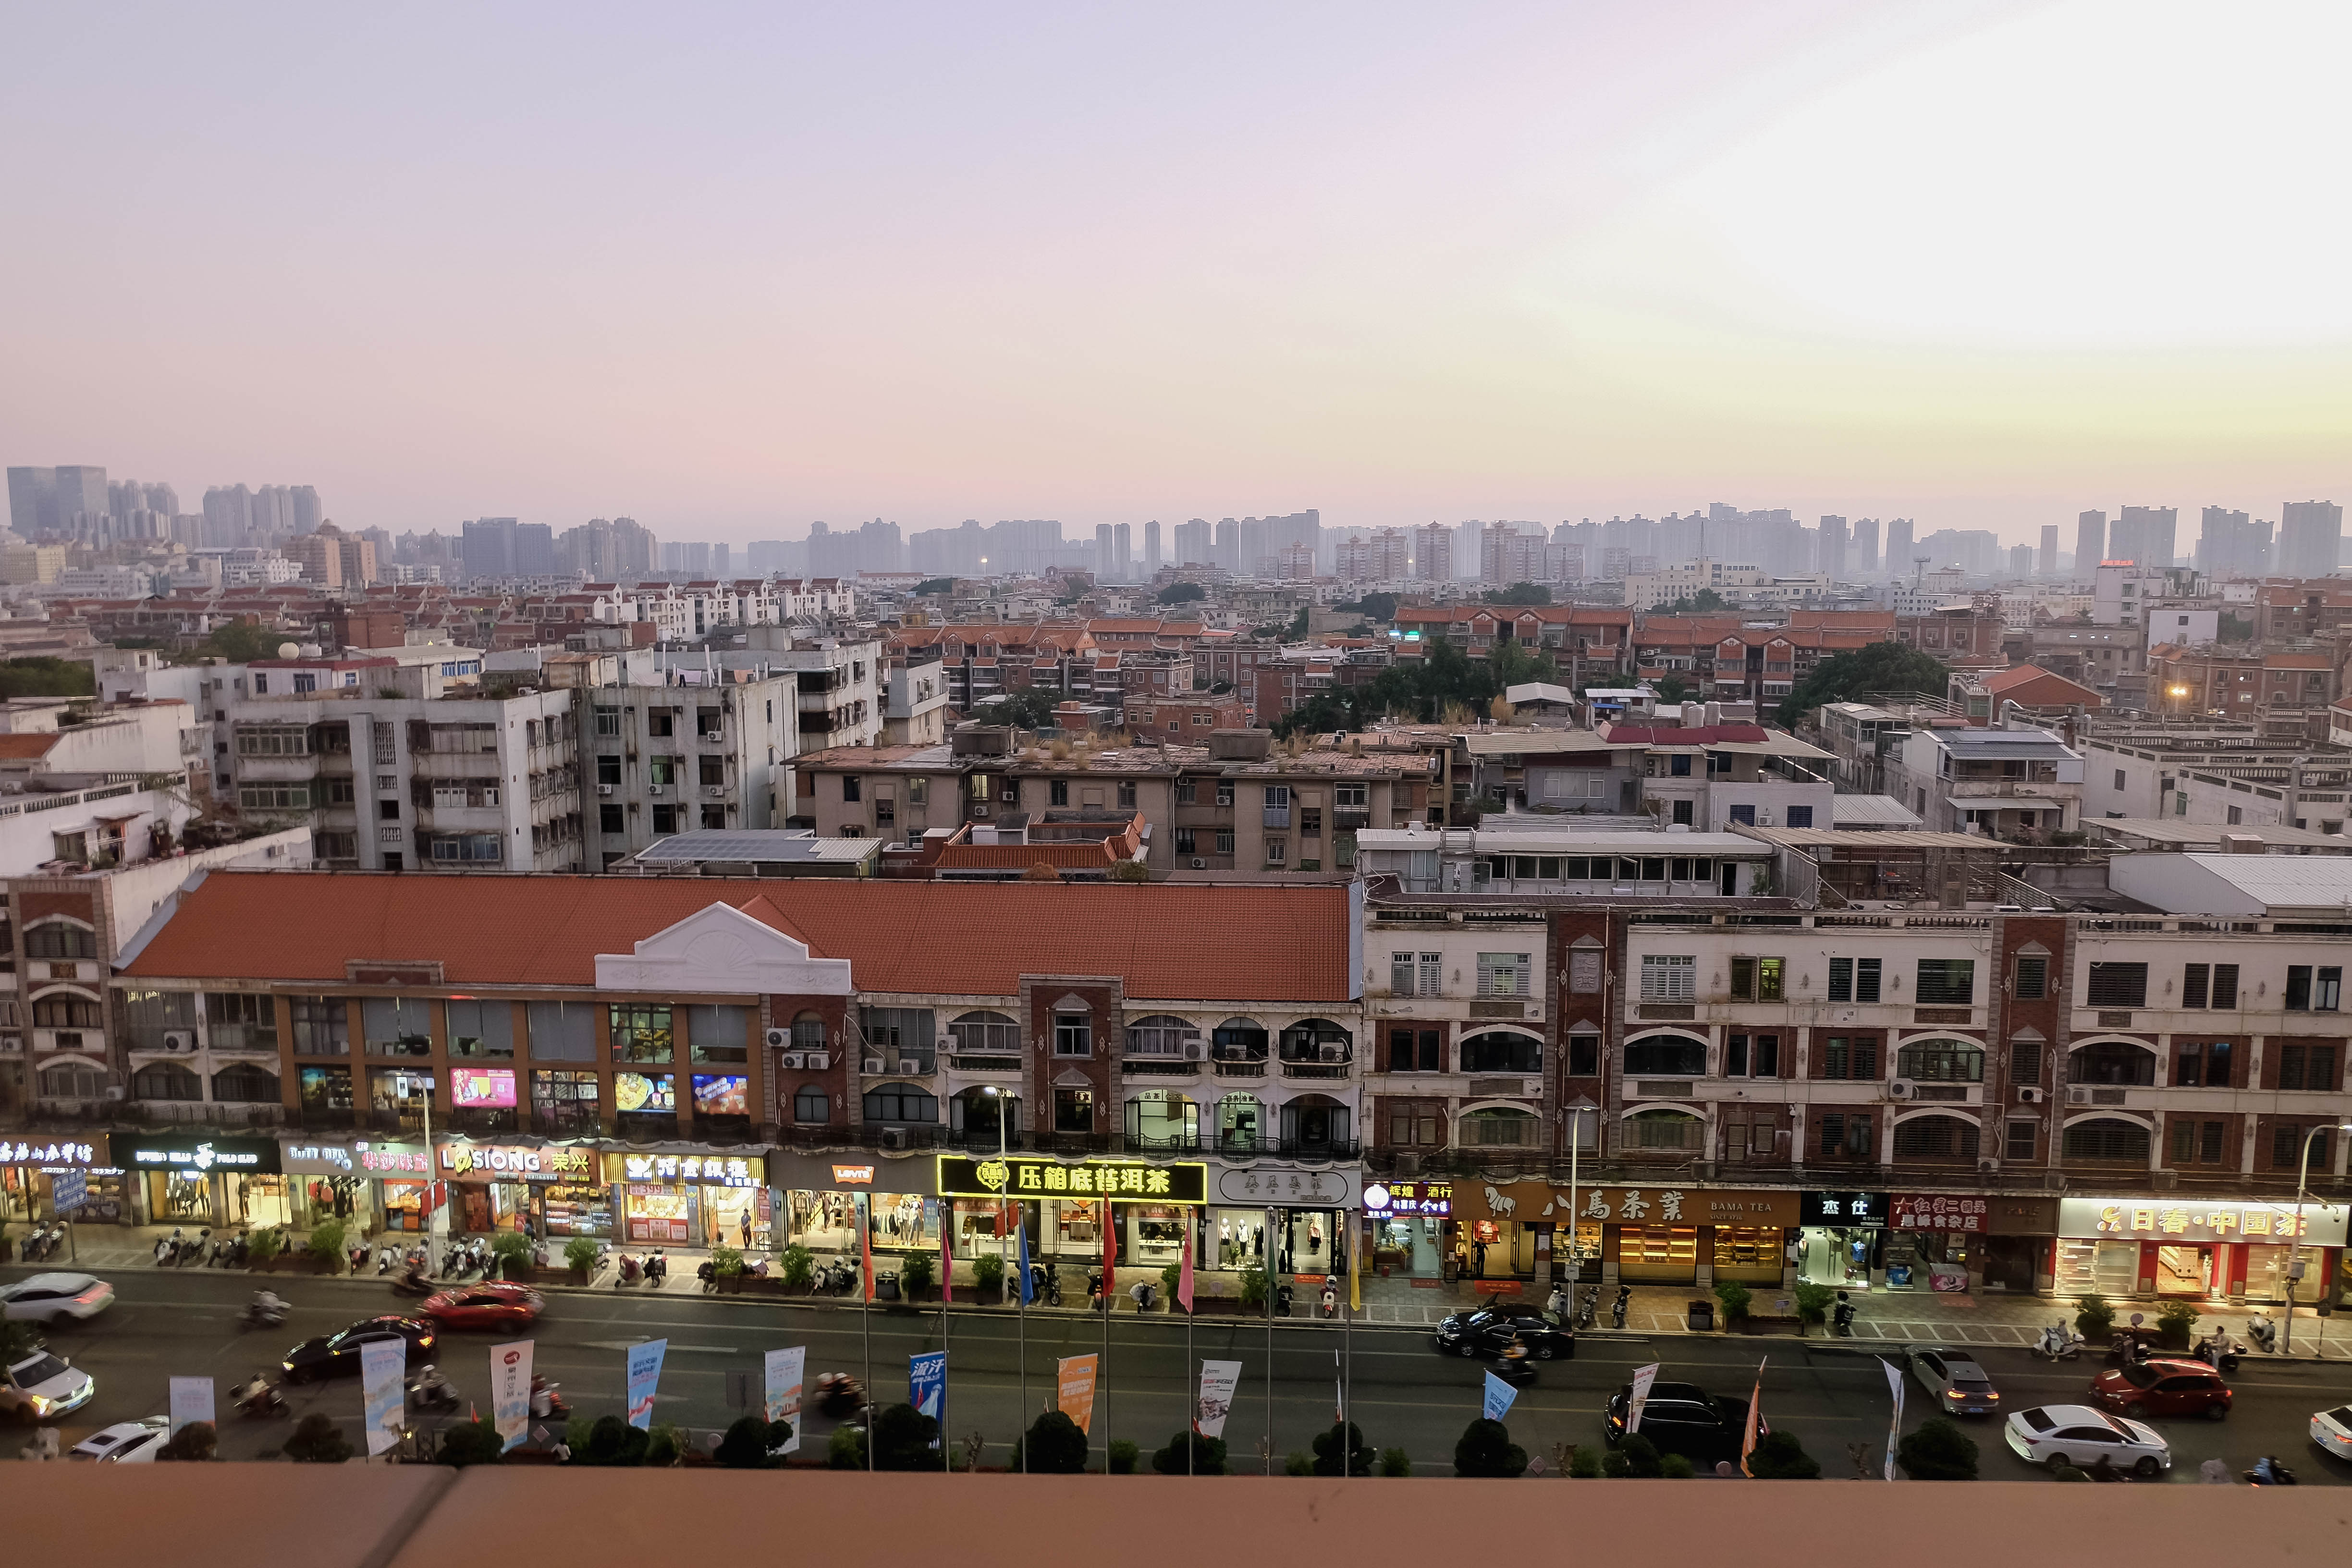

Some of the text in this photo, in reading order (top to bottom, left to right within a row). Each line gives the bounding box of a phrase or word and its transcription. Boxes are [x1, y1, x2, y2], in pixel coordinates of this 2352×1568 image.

[551, 1152, 589, 1173] 荣兴
[1019, 1165, 1170, 1193] 压箱底普洱茶
[1389, 1185, 1453, 1198] 辉煌 酒行
[1711, 1202, 1772, 1211] BAMA TEA
[1822, 1200, 1868, 1215] 杰仕
